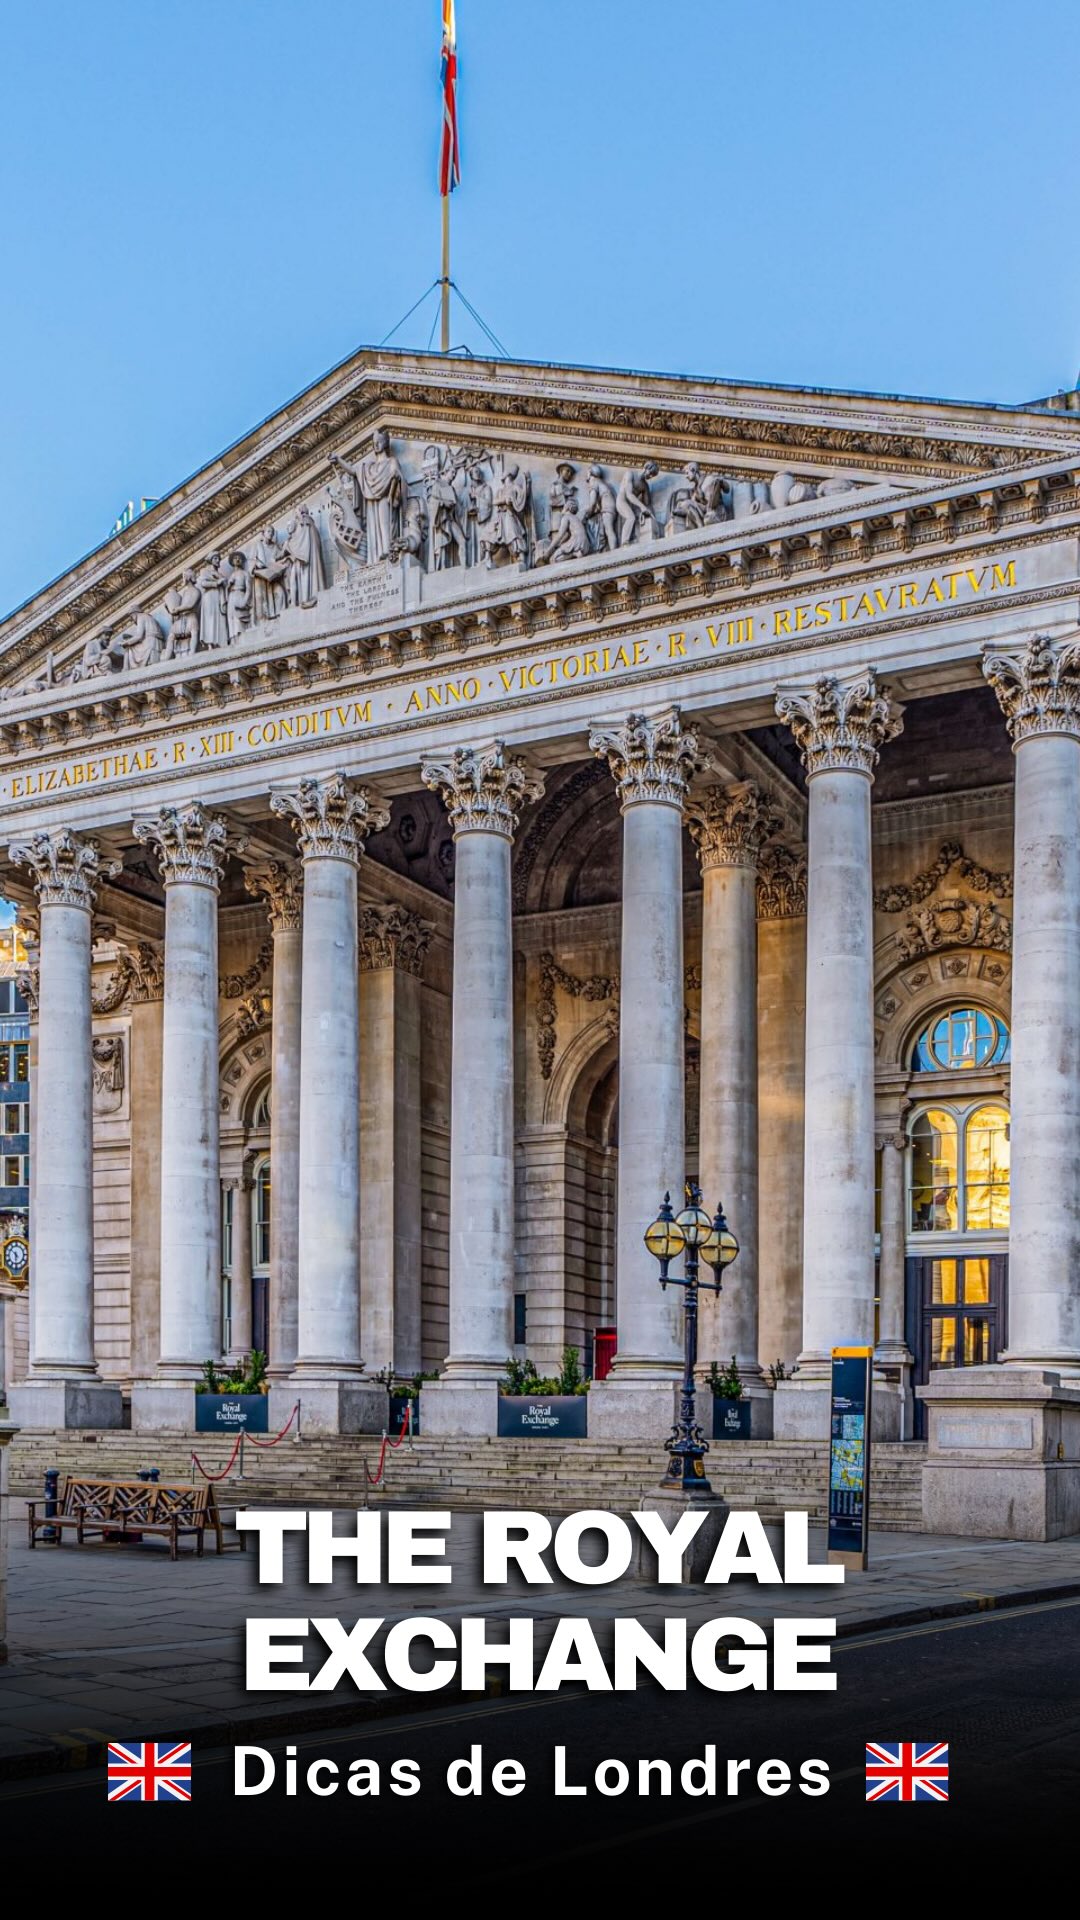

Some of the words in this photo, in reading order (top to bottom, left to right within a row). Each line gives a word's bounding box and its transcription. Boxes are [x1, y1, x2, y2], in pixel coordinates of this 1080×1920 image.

[340, 584, 354, 592] THE
[346, 590, 361, 599] THE
[332, 602, 346, 610] AND
[350, 597, 364, 606] THE
[349, 600, 384, 613] THEREOF
[12, 747, 159, 798] ELIZABETHAE
[172, 741, 186, 764] R
[200, 730, 236, 758] XIII
[247, 699, 373, 747] CONDITVM
[404, 676, 481, 714] ANNO
[499, 639, 650, 693] VICTORIAE
[667, 631, 688, 658] R
[705, 617, 754, 649] VIII
[773, 560, 1018, 637] RESTAVRATVM
[222, 1403, 241, 1414] Royal
[528, 1405, 551, 1417] Royal
[216, 1411, 248, 1422] Exchange
[521, 1414, 560, 1427] Exchange
